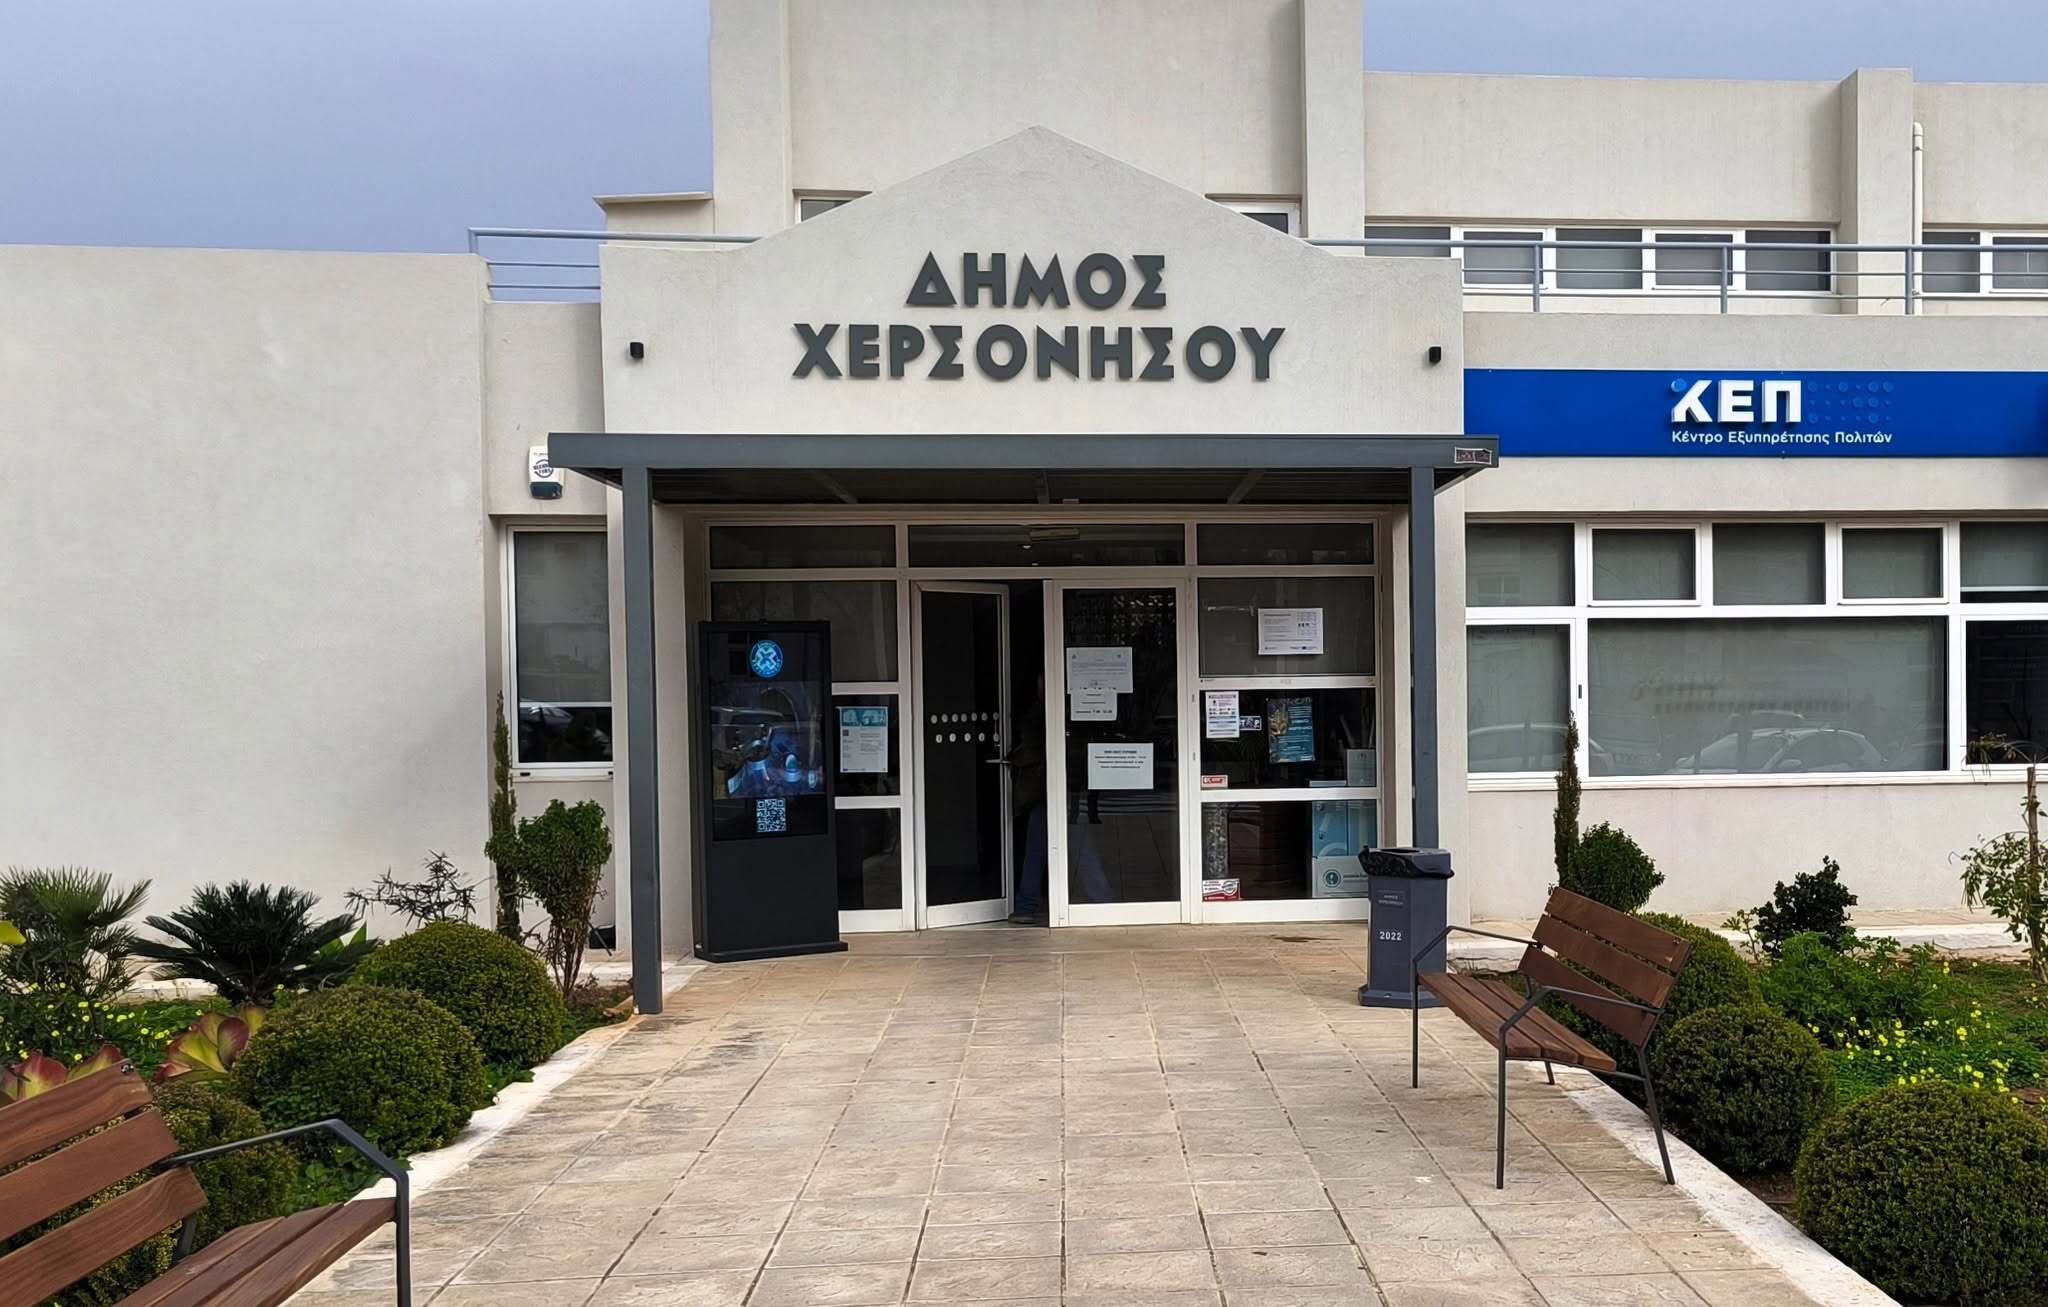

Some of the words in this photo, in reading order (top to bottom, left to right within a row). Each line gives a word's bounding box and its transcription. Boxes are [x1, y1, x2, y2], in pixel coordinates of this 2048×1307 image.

[906, 252, 1167, 311] ΔΗΜΟΣ
[793, 323, 1286, 384] ΧΕΡΣΟΝΗΣΟΥ
[1671, 379, 1802, 423] ΚΕΠ
[1671, 430, 1723, 445] Κέντρο
[1728, 430, 1830, 446] Εξυπηρέτησης
[1835, 430, 1893, 443] Πολιτών
[1379, 931, 1402, 941] 2022
